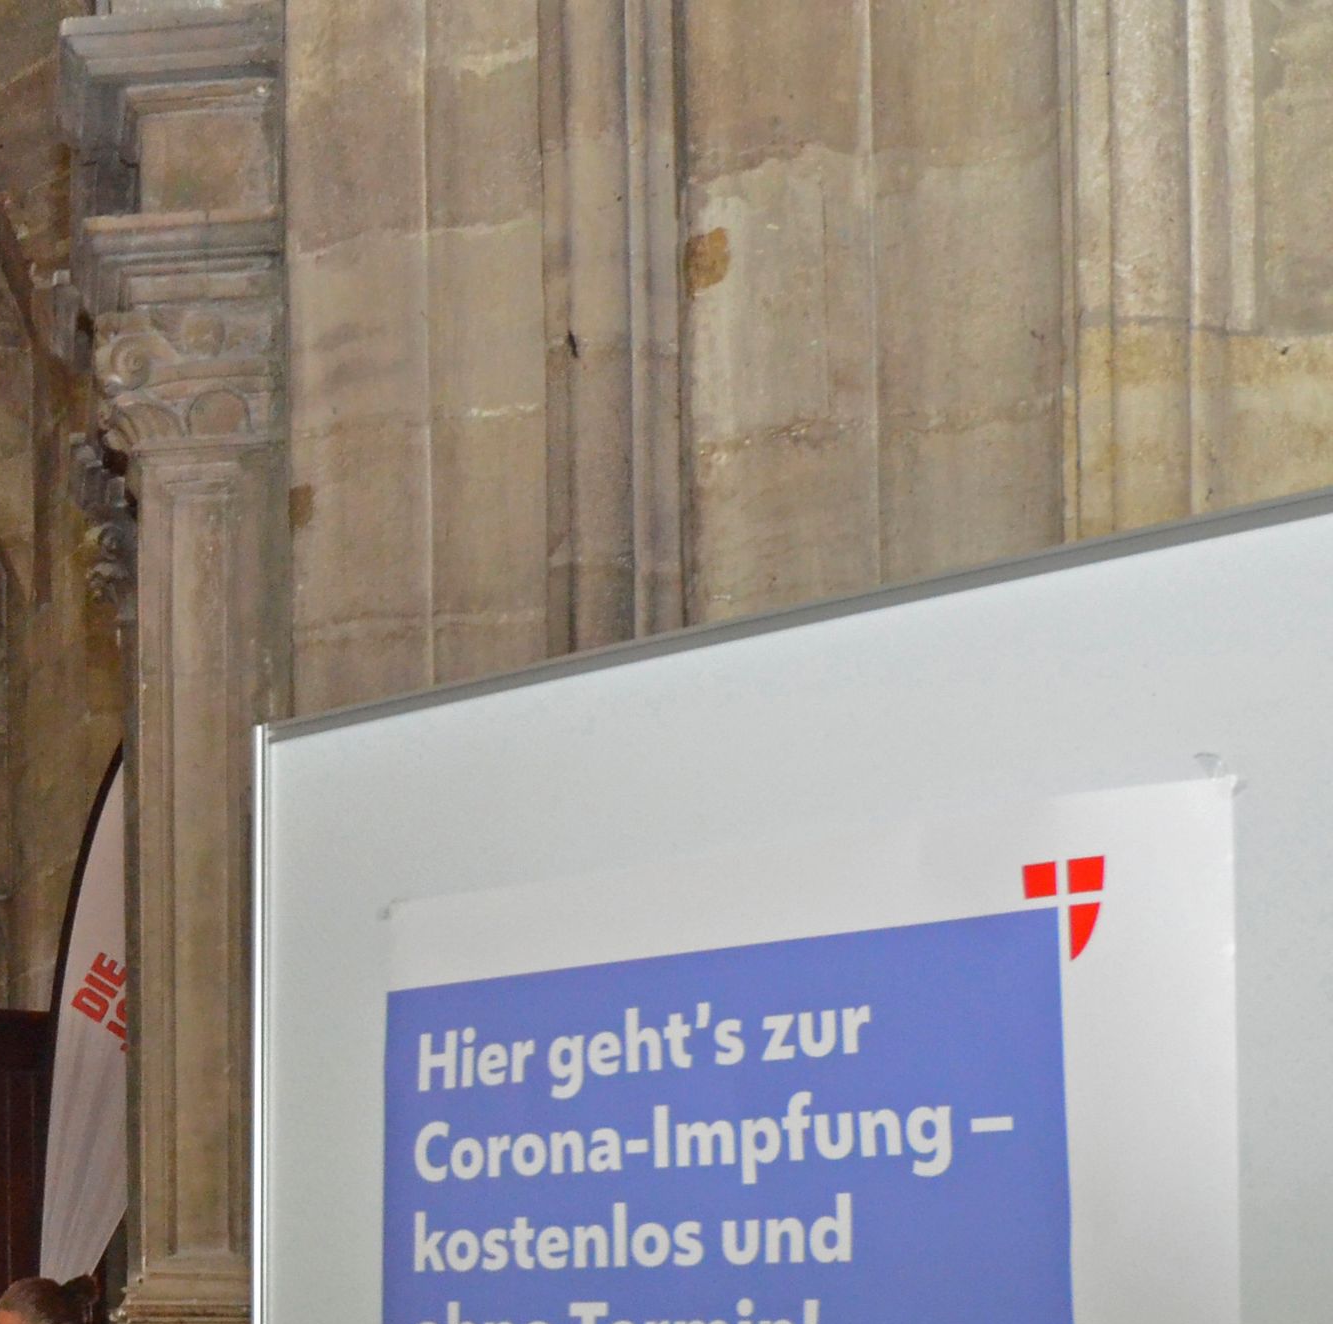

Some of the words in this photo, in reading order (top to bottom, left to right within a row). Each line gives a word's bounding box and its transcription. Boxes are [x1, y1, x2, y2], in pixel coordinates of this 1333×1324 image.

[70, 952, 129, 1024] DIE
[418, 1027, 535, 1092] Hier
[547, 1001, 746, 1100] geht’s
[761, 1005, 872, 1062] zur
[414, 1091, 953, 1185] Corona-Impfung
[413, 1201, 704, 1273] kostenlos
[721, 1192, 852, 1266] und
